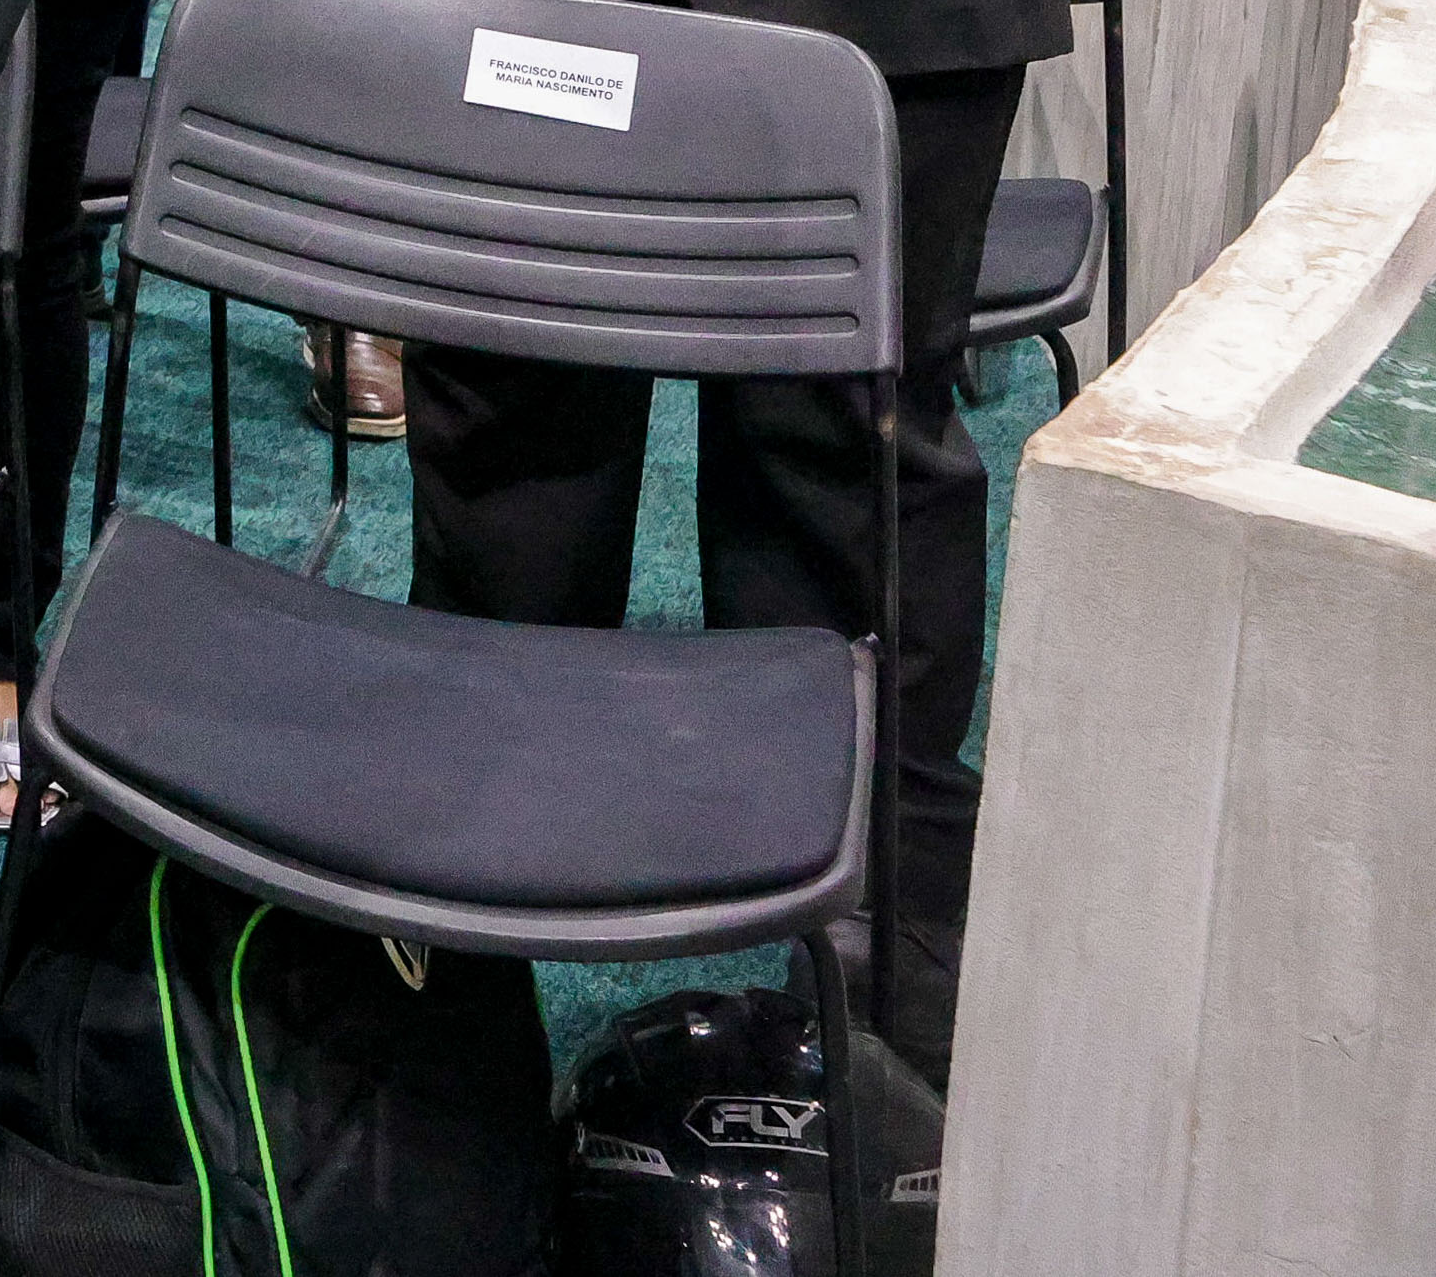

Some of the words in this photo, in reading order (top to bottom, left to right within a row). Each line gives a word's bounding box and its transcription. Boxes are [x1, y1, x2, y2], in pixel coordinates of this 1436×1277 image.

[489, 58, 557, 79] FRANCISCO
[560, 71, 604, 87] DANILO
[607, 79, 624, 90] DE
[496, 72, 533, 87] MARIA
[536, 79, 614, 101] NASCIMENTO
[711, 1104, 818, 1139] FLY
